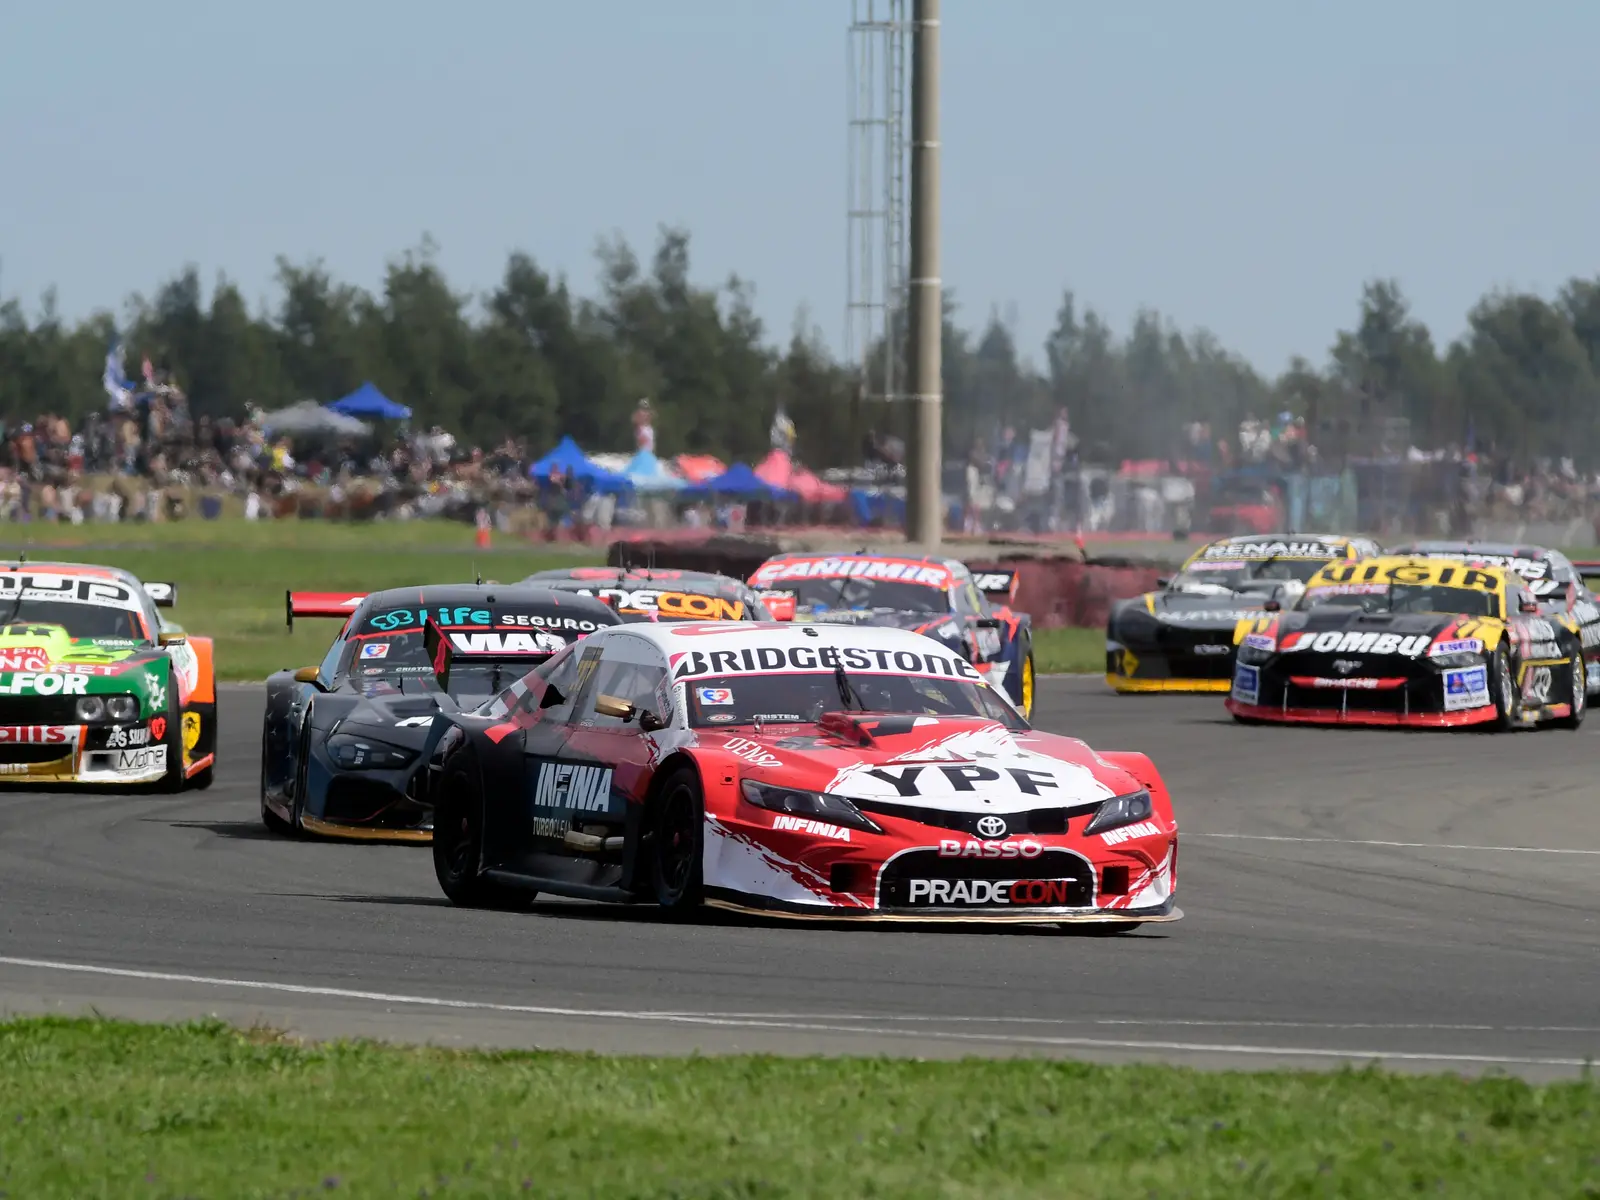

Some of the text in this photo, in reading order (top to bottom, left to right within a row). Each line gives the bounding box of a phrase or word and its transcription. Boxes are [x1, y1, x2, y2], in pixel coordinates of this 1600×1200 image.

[673, 646, 981, 680] BRIDGESTONE
[723, 737, 783, 767] DENSO
[535, 763, 613, 812] INFINIA
[862, 765, 1060, 797] YPF
[773, 815, 851, 842] INFINIA
[1100, 821, 1162, 846] INFINIA
[940, 840, 1043, 858] BASSO
[909, 878, 1067, 904] PRADECON
